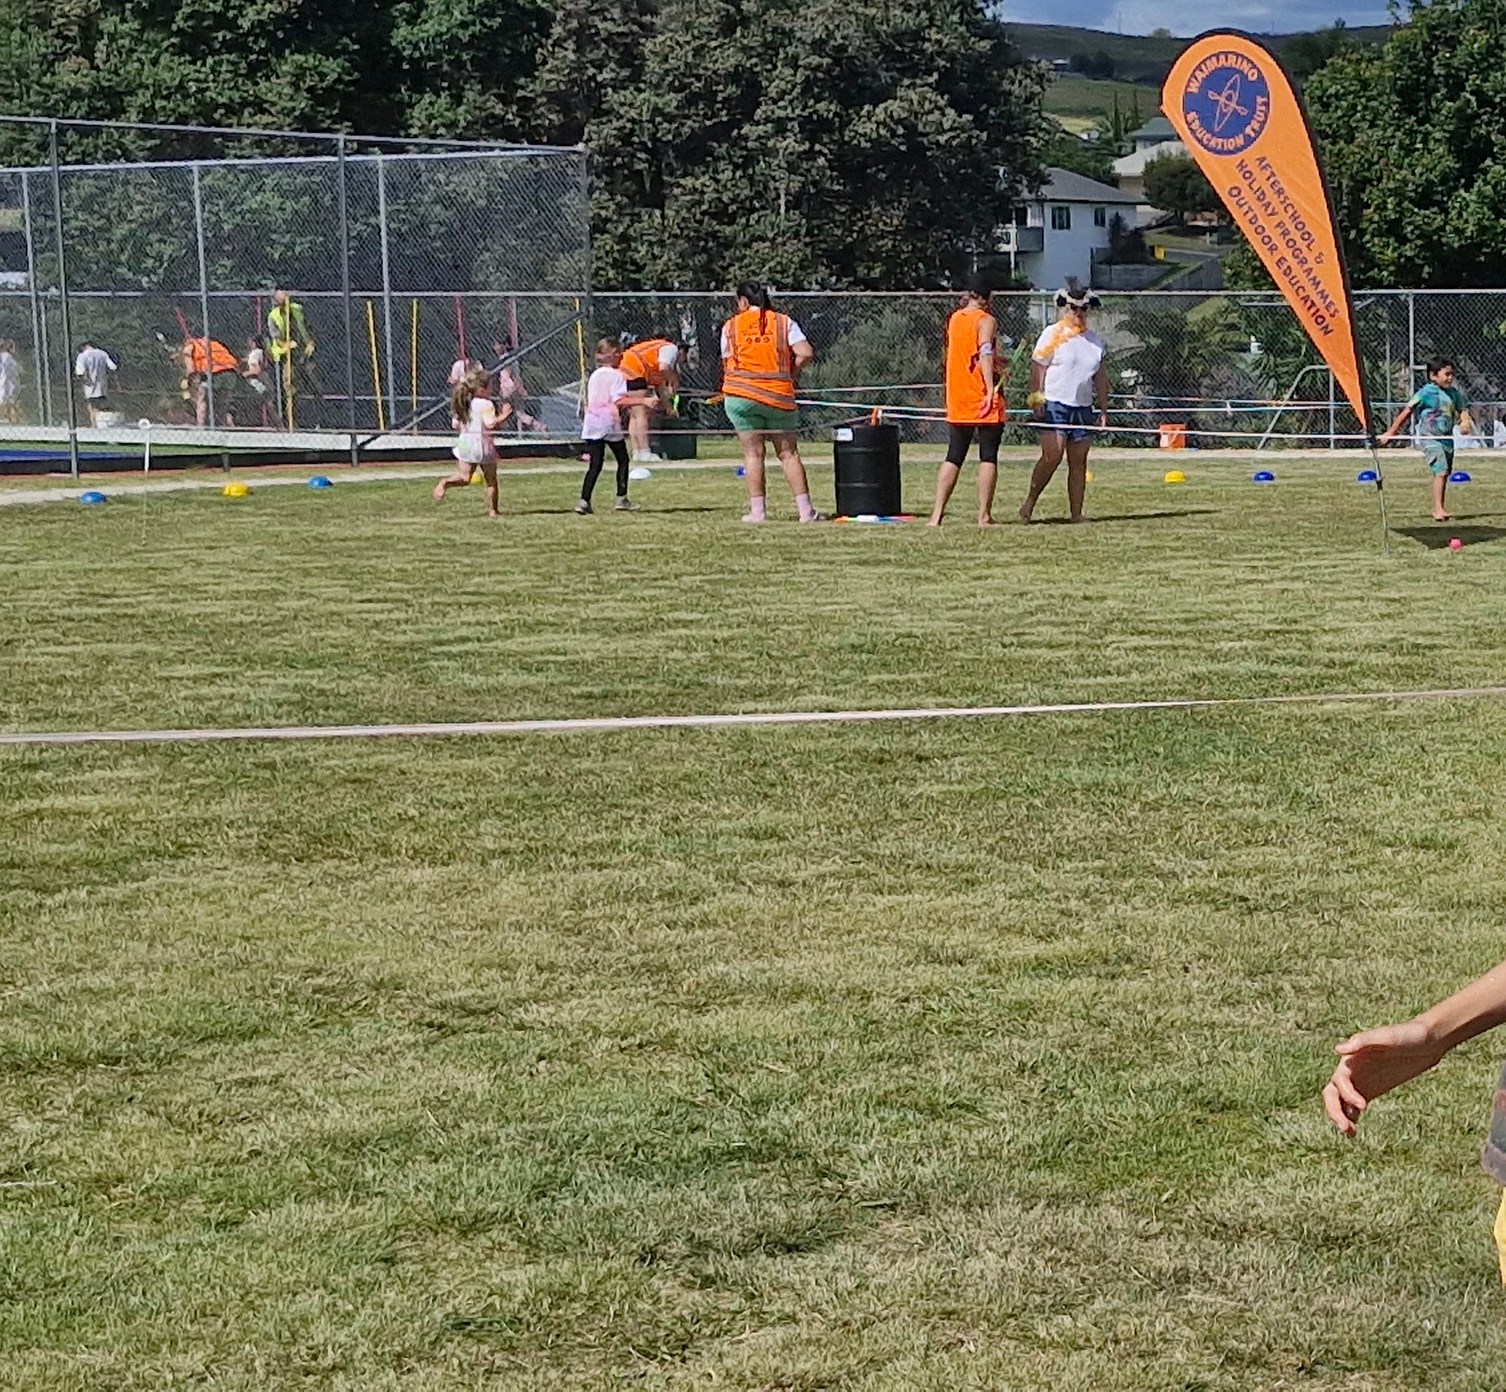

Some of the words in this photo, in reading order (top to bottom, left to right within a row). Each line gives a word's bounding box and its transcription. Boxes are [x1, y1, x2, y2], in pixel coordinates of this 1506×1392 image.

[1186, 111, 1245, 150] EDUCATION
[1245, 95, 1268, 138] TRUST
[1187, 54, 1258, 93] WAIMARINO
[1227, 184, 1278, 257] OUTDOOR
[1275, 255, 1335, 337] EDUCATION
[1234, 158, 1278, 222] HOLIDAY
[1274, 218, 1340, 319] PROGRAMMES
[1255, 156, 1317, 252] AFTERSCHOOL
[1313, 250, 1327, 265] &
